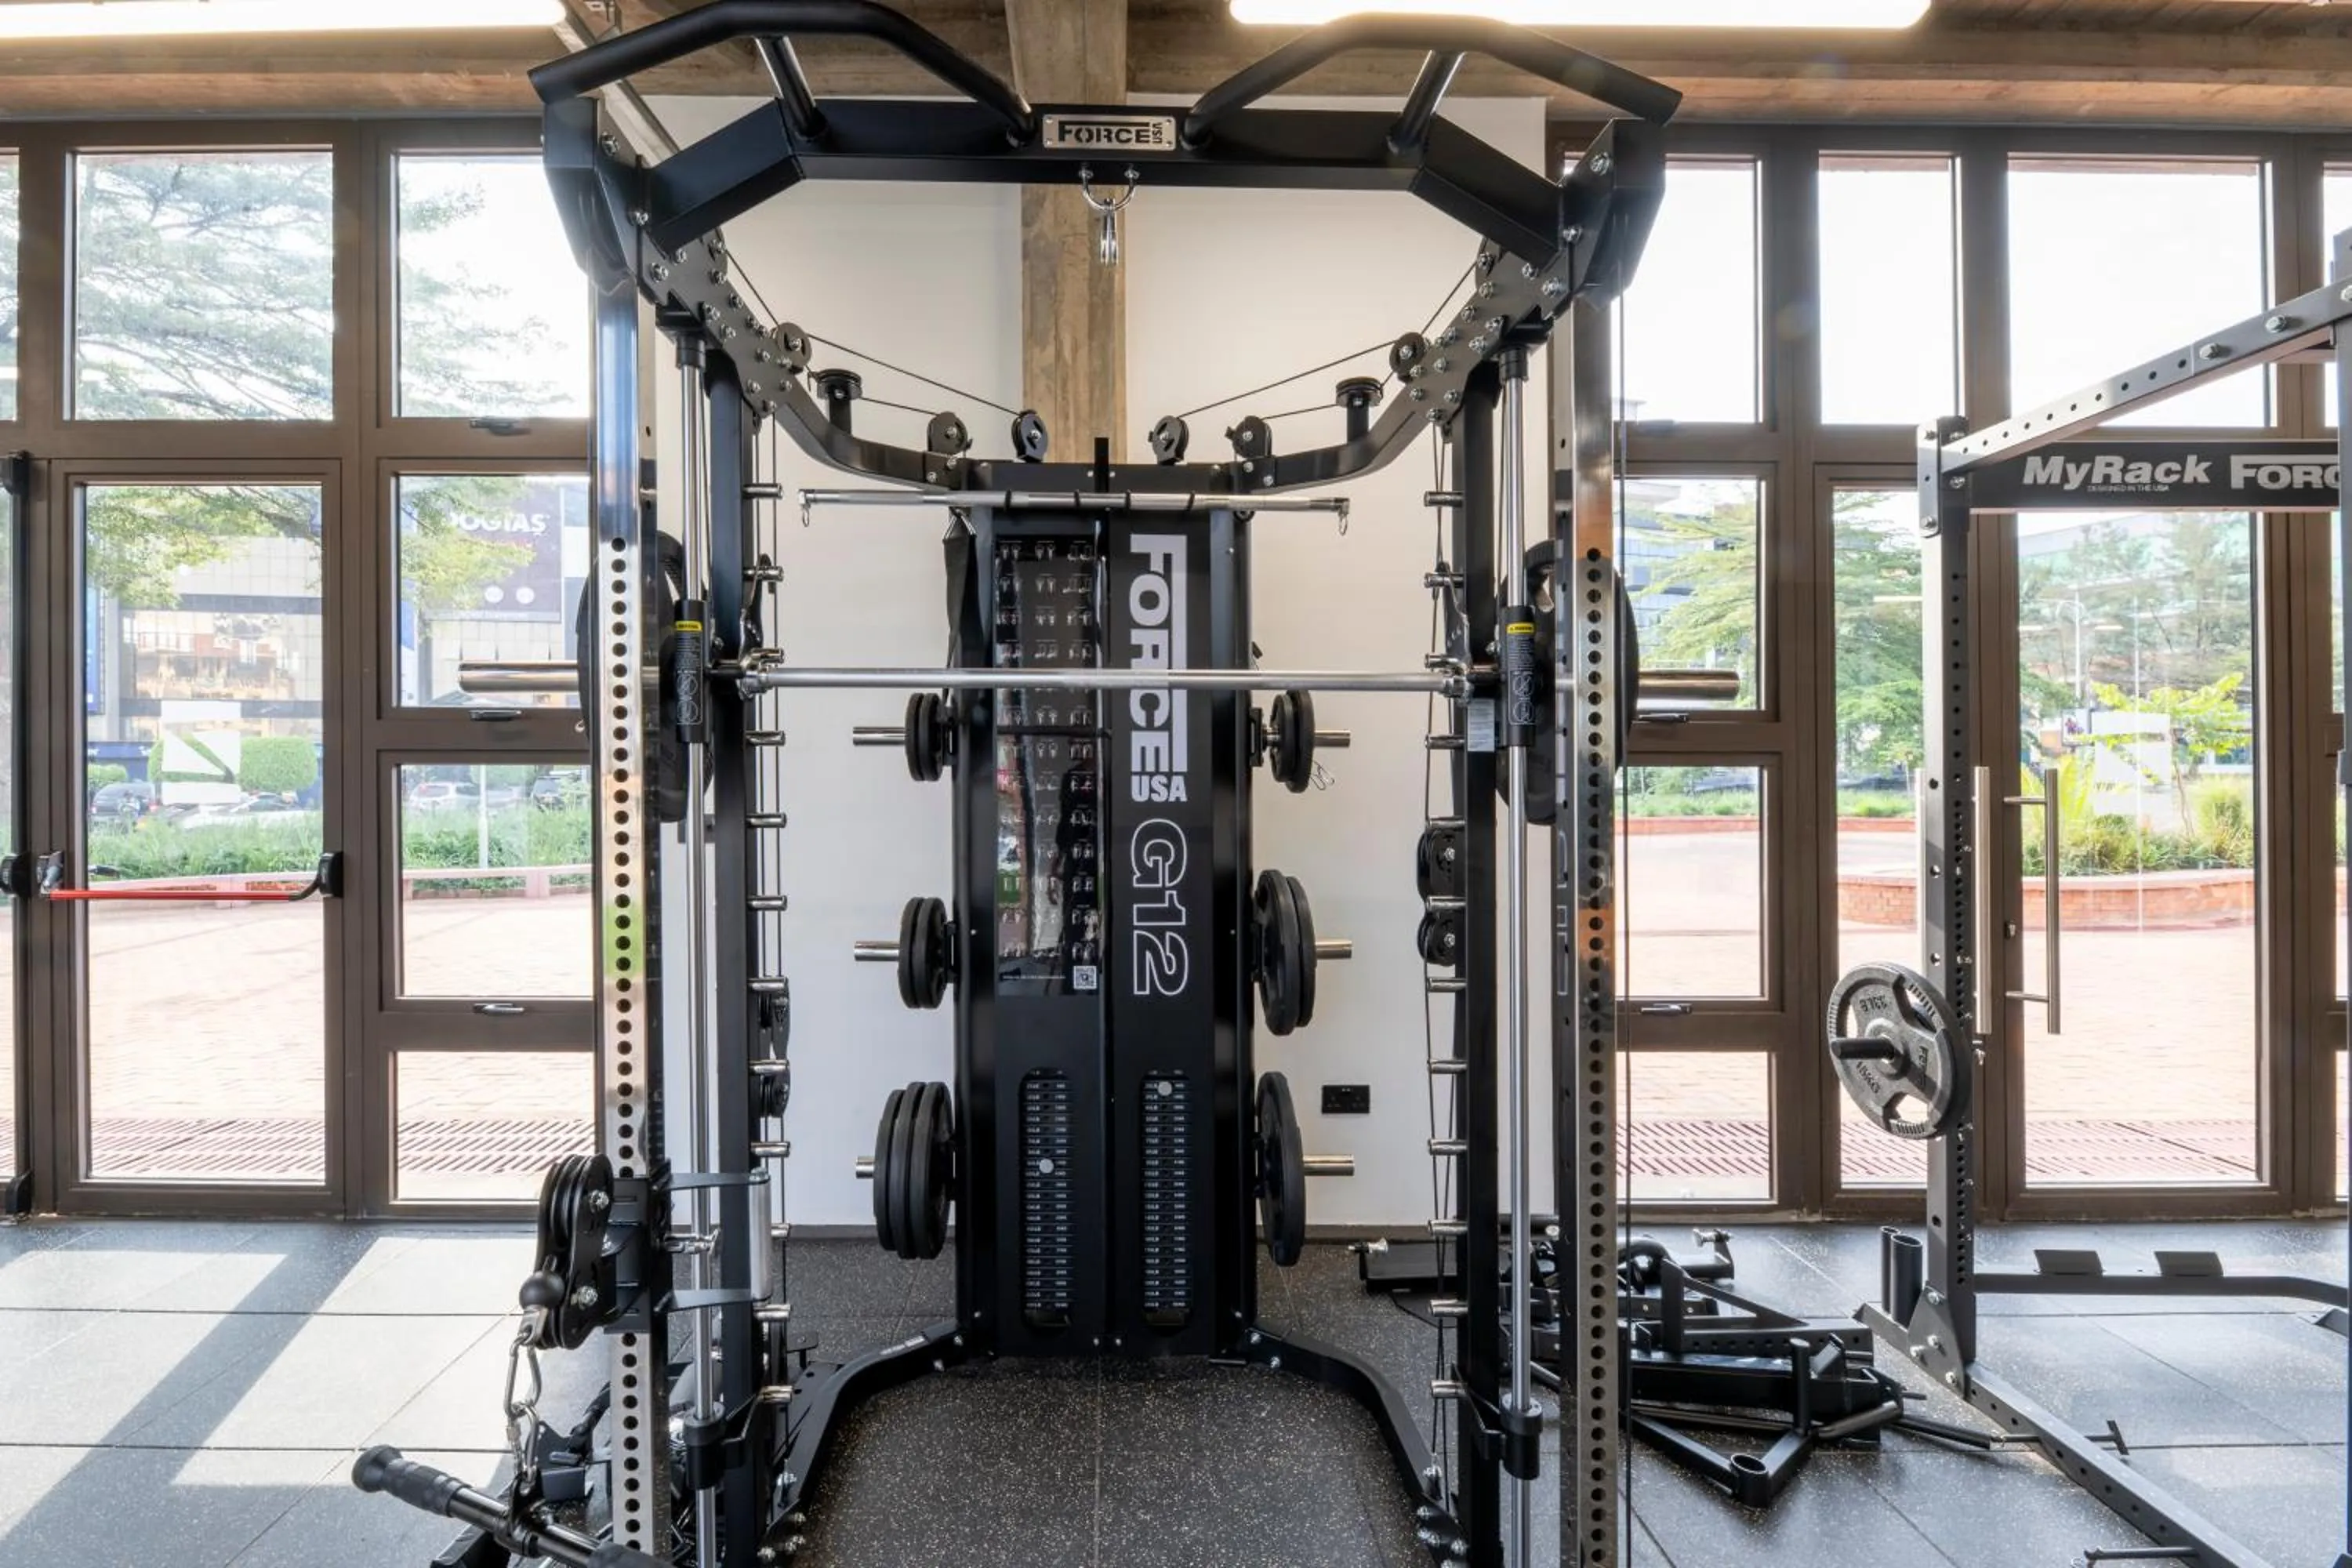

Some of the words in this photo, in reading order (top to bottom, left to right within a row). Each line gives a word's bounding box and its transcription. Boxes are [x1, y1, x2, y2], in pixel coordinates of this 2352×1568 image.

[1058, 120, 1150, 143] FORCE
[1152, 122, 1163, 144] USA
[2023, 454, 2212, 490] MyRack
[1129, 534, 1187, 772] FORCE
[1131, 775, 1187, 803] USA
[1131, 818, 1189, 996] G12
